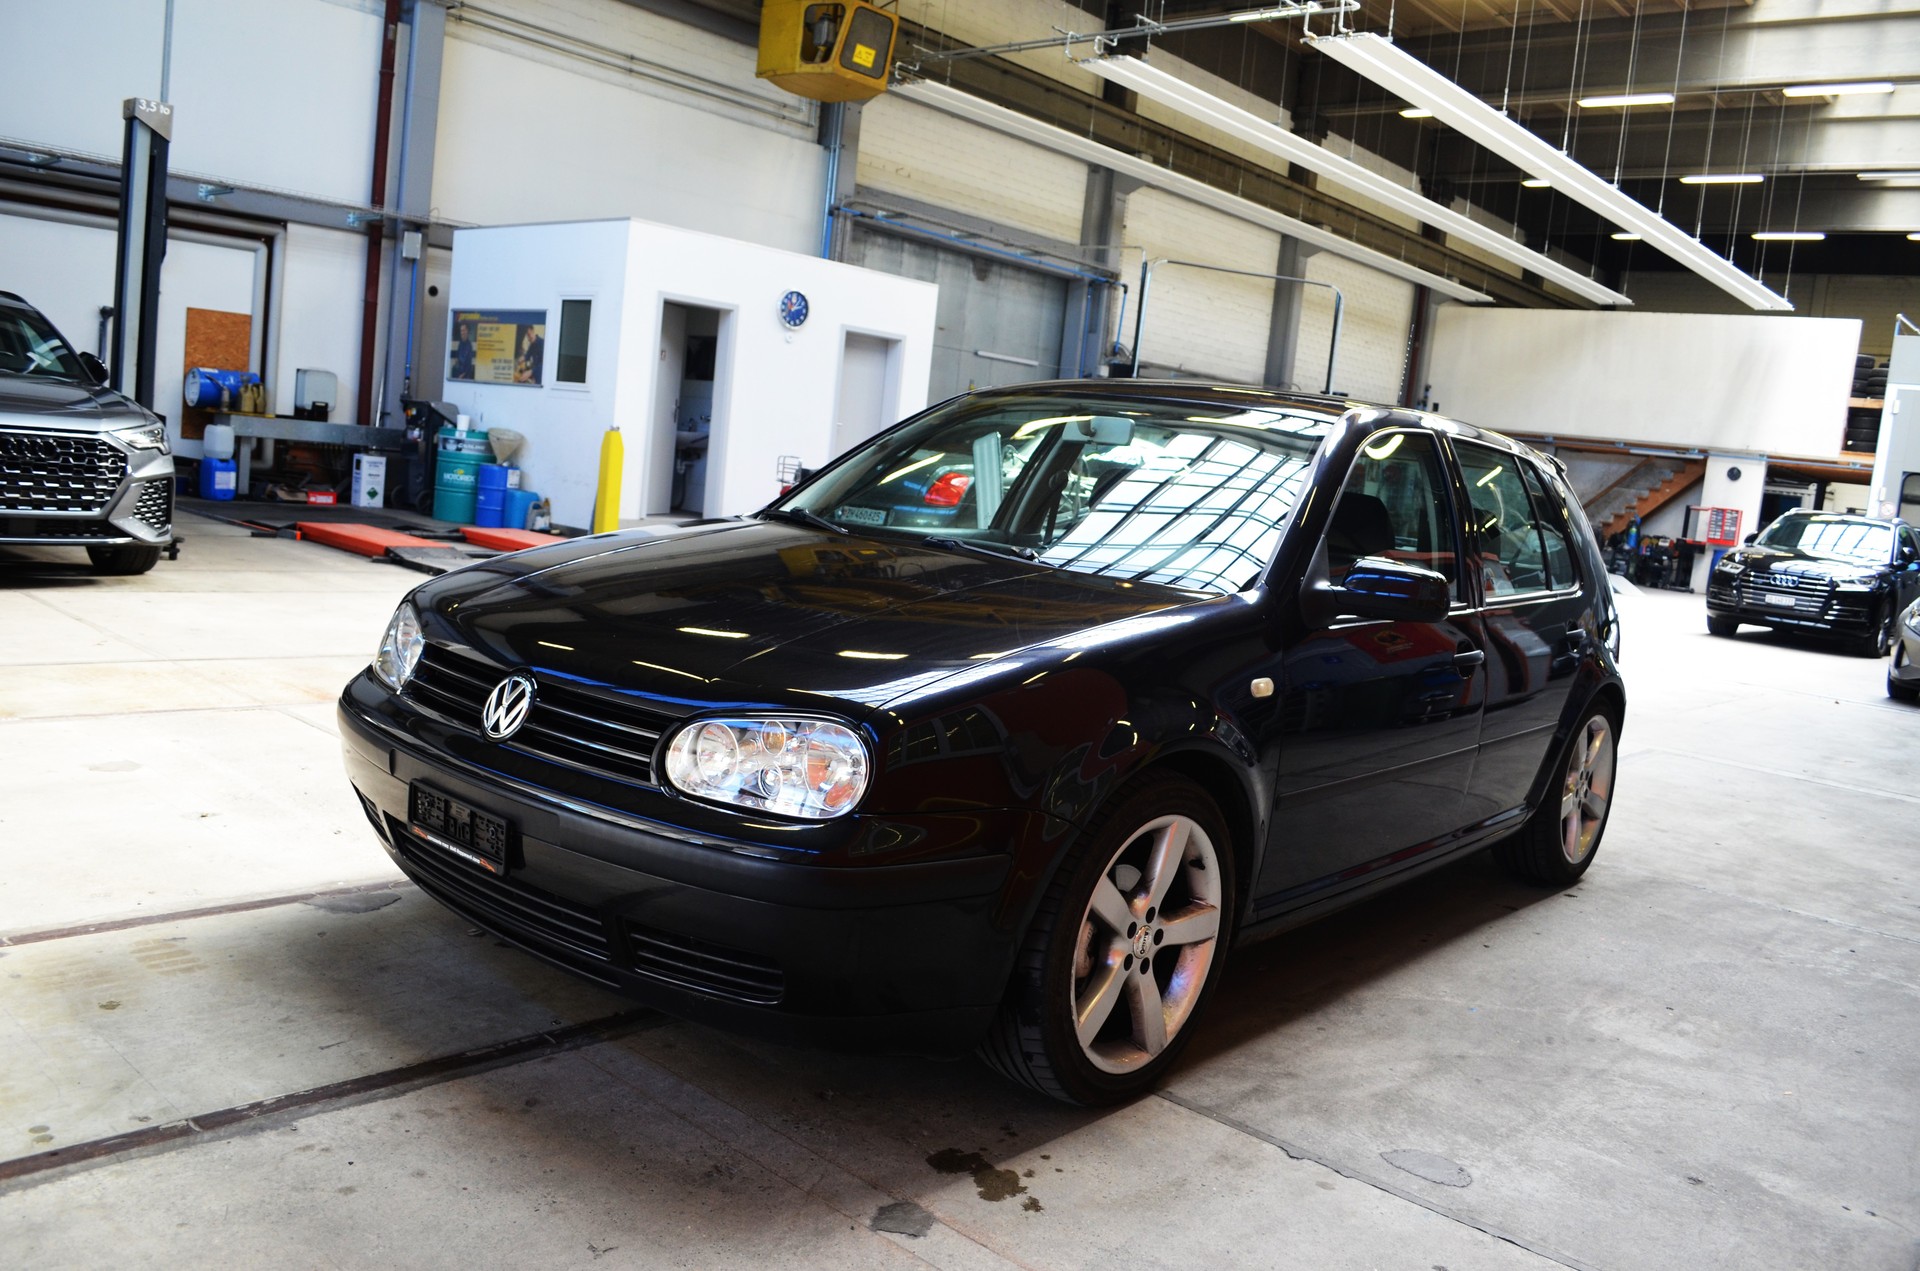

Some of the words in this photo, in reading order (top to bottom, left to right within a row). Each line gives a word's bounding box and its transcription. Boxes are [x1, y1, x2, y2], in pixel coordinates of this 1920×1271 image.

[139, 99, 157, 112] 3,5
[443, 472, 476, 482] MOTOREX
[483, 676, 532, 739] VW
